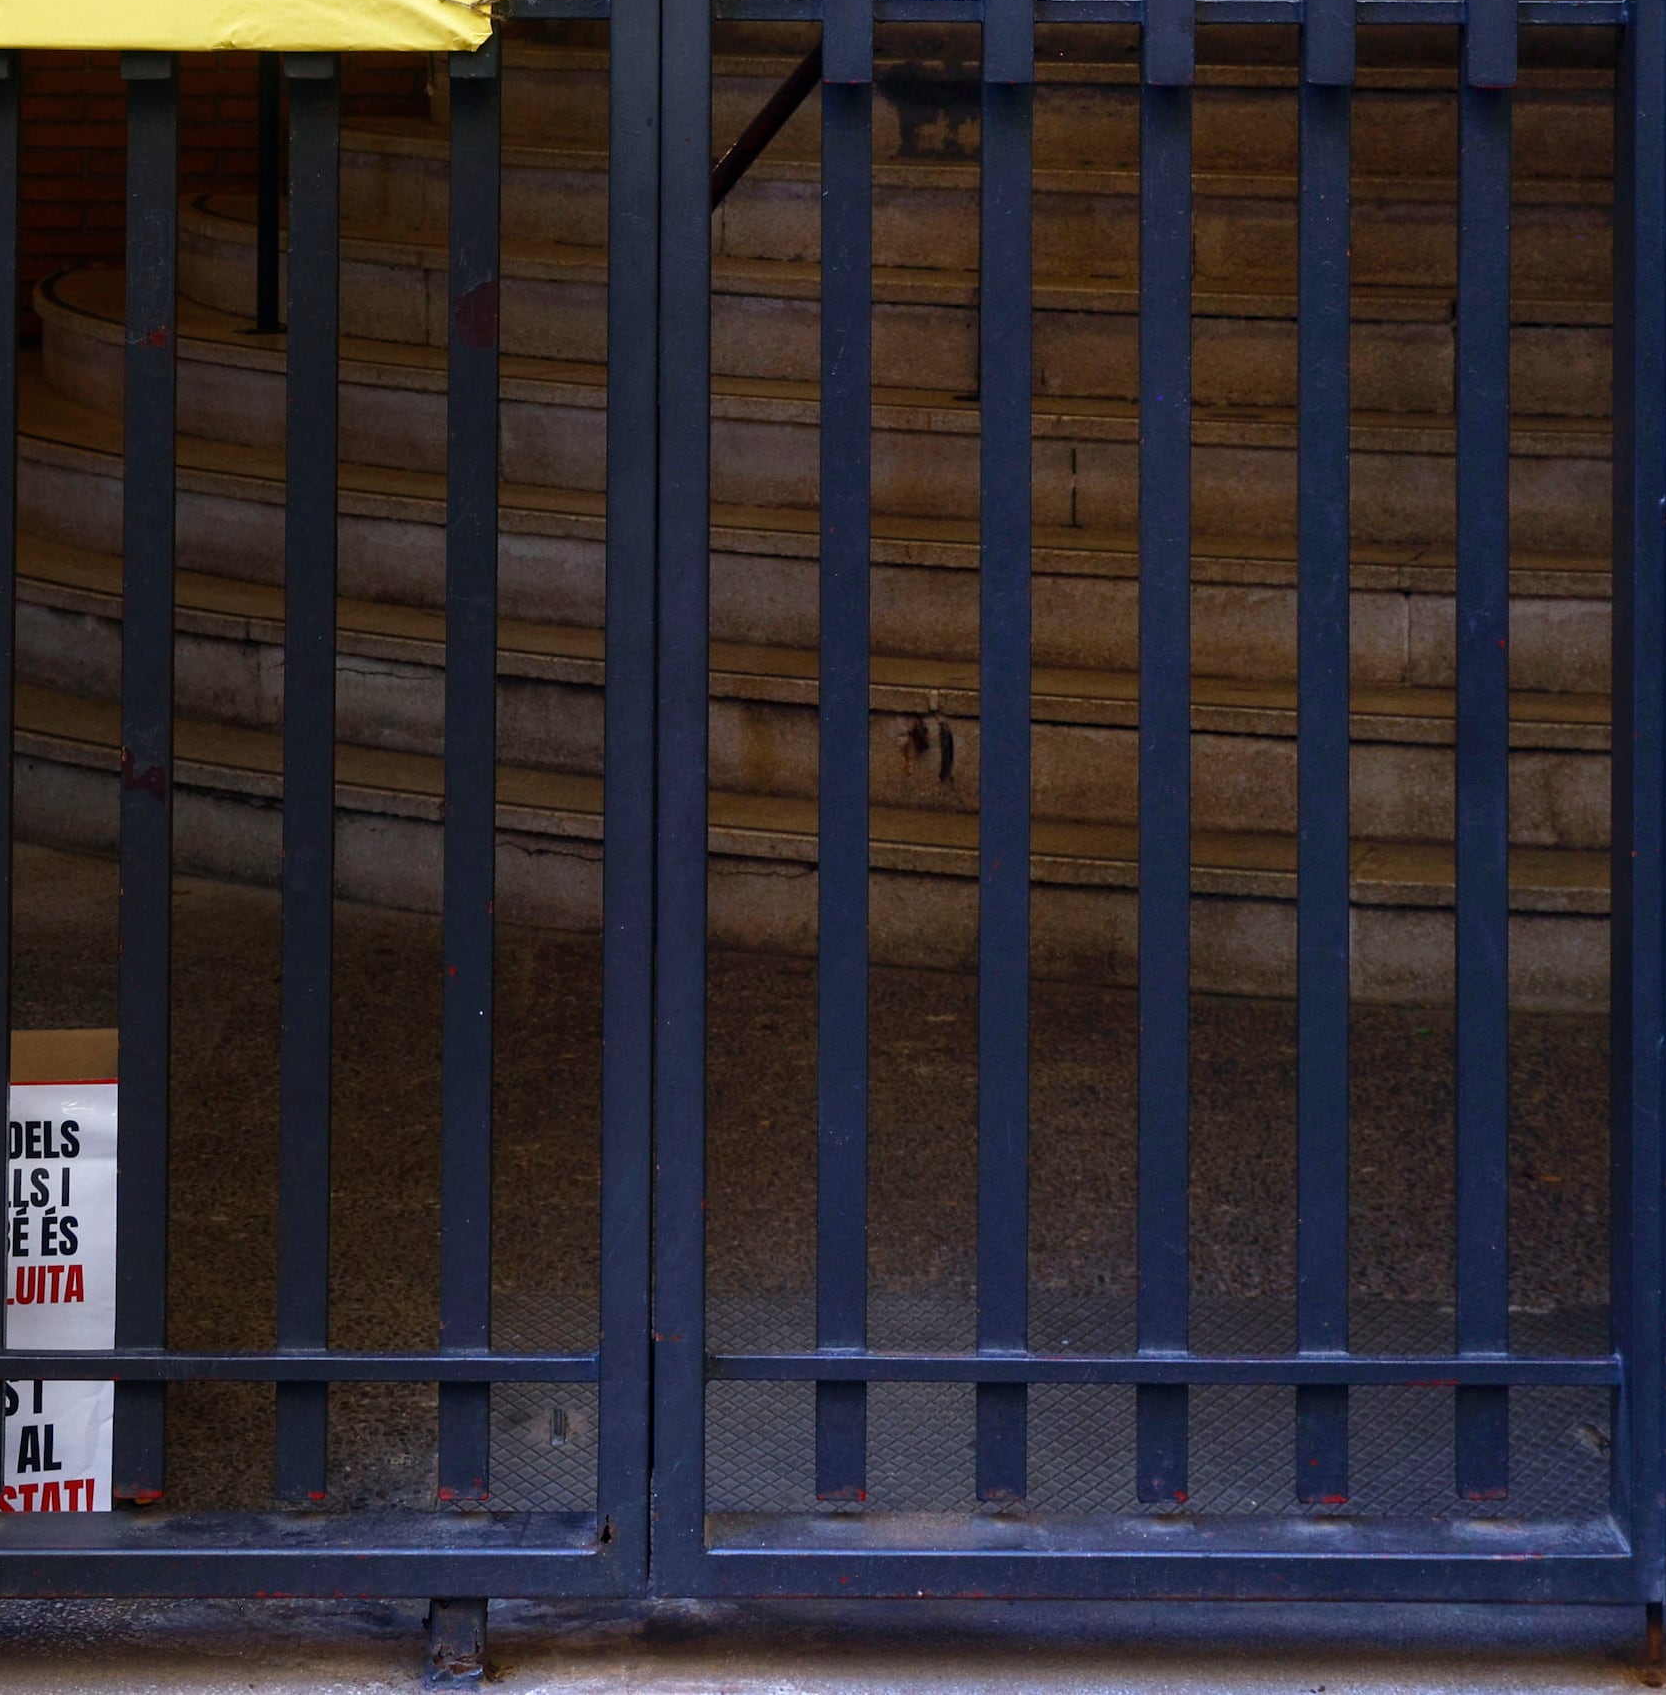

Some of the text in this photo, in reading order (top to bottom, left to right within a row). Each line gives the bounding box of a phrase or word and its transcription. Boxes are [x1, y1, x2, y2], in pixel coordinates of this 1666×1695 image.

[61, 1167, 71, 1207] I
[41, 1207, 79, 1257] ÉS
[17, 1424, 62, 1474] AL
